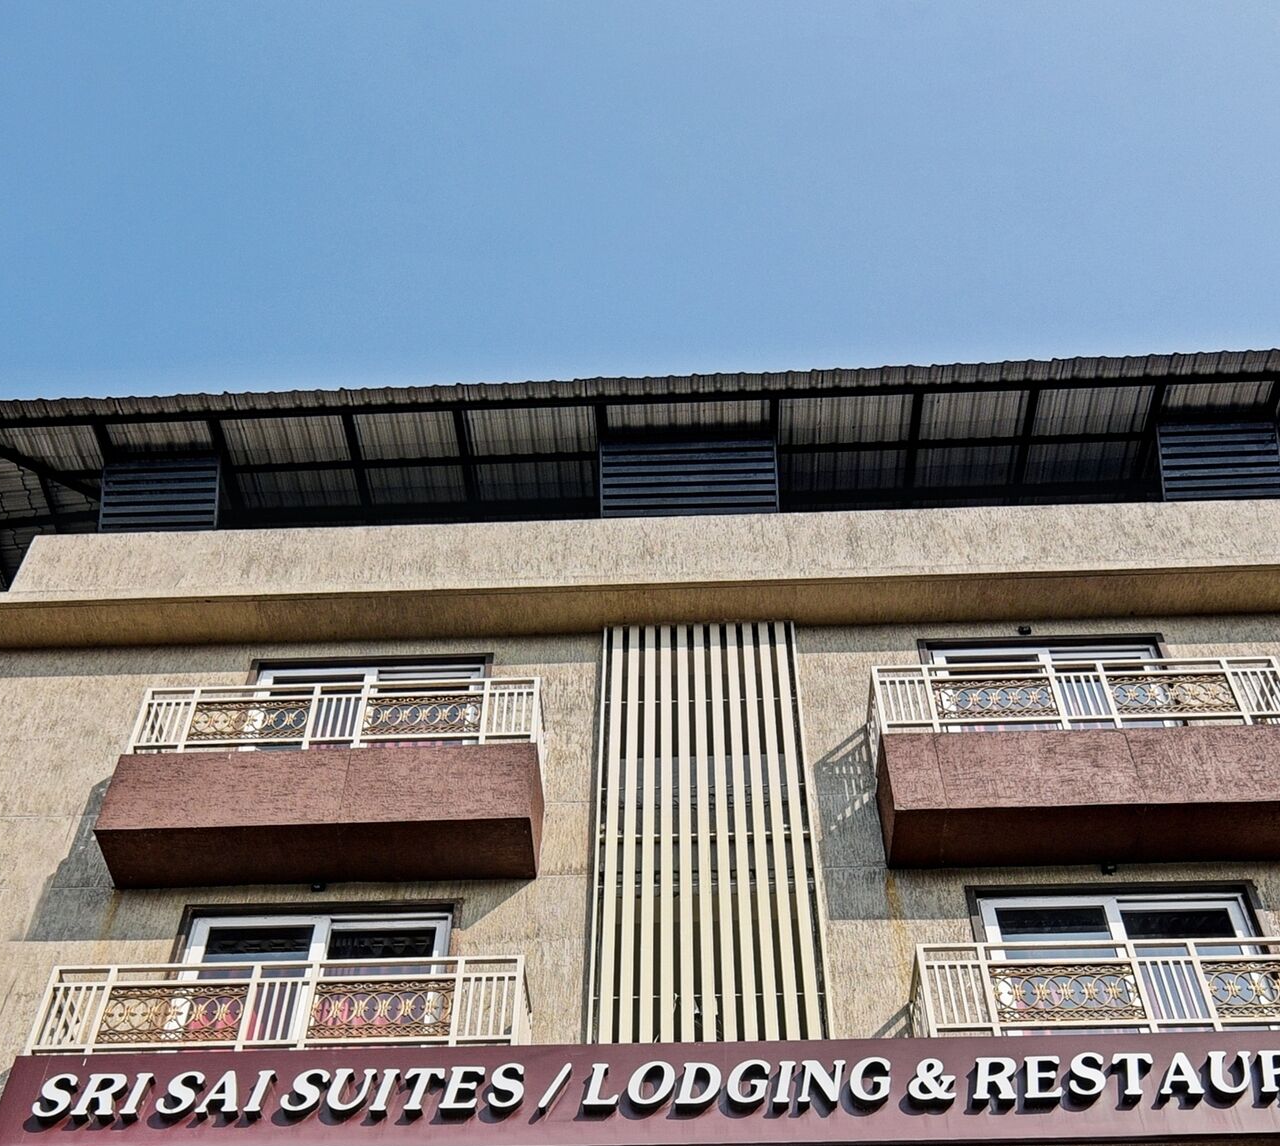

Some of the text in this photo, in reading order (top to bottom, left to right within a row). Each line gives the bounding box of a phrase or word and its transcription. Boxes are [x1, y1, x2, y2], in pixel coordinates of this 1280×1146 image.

[32, 1072, 156, 1120] SRI
[156, 1069, 278, 1119] SAI
[279, 1063, 526, 1115] SUITES
[582, 1056, 892, 1106] LODGING
[908, 1058, 957, 1102] &
